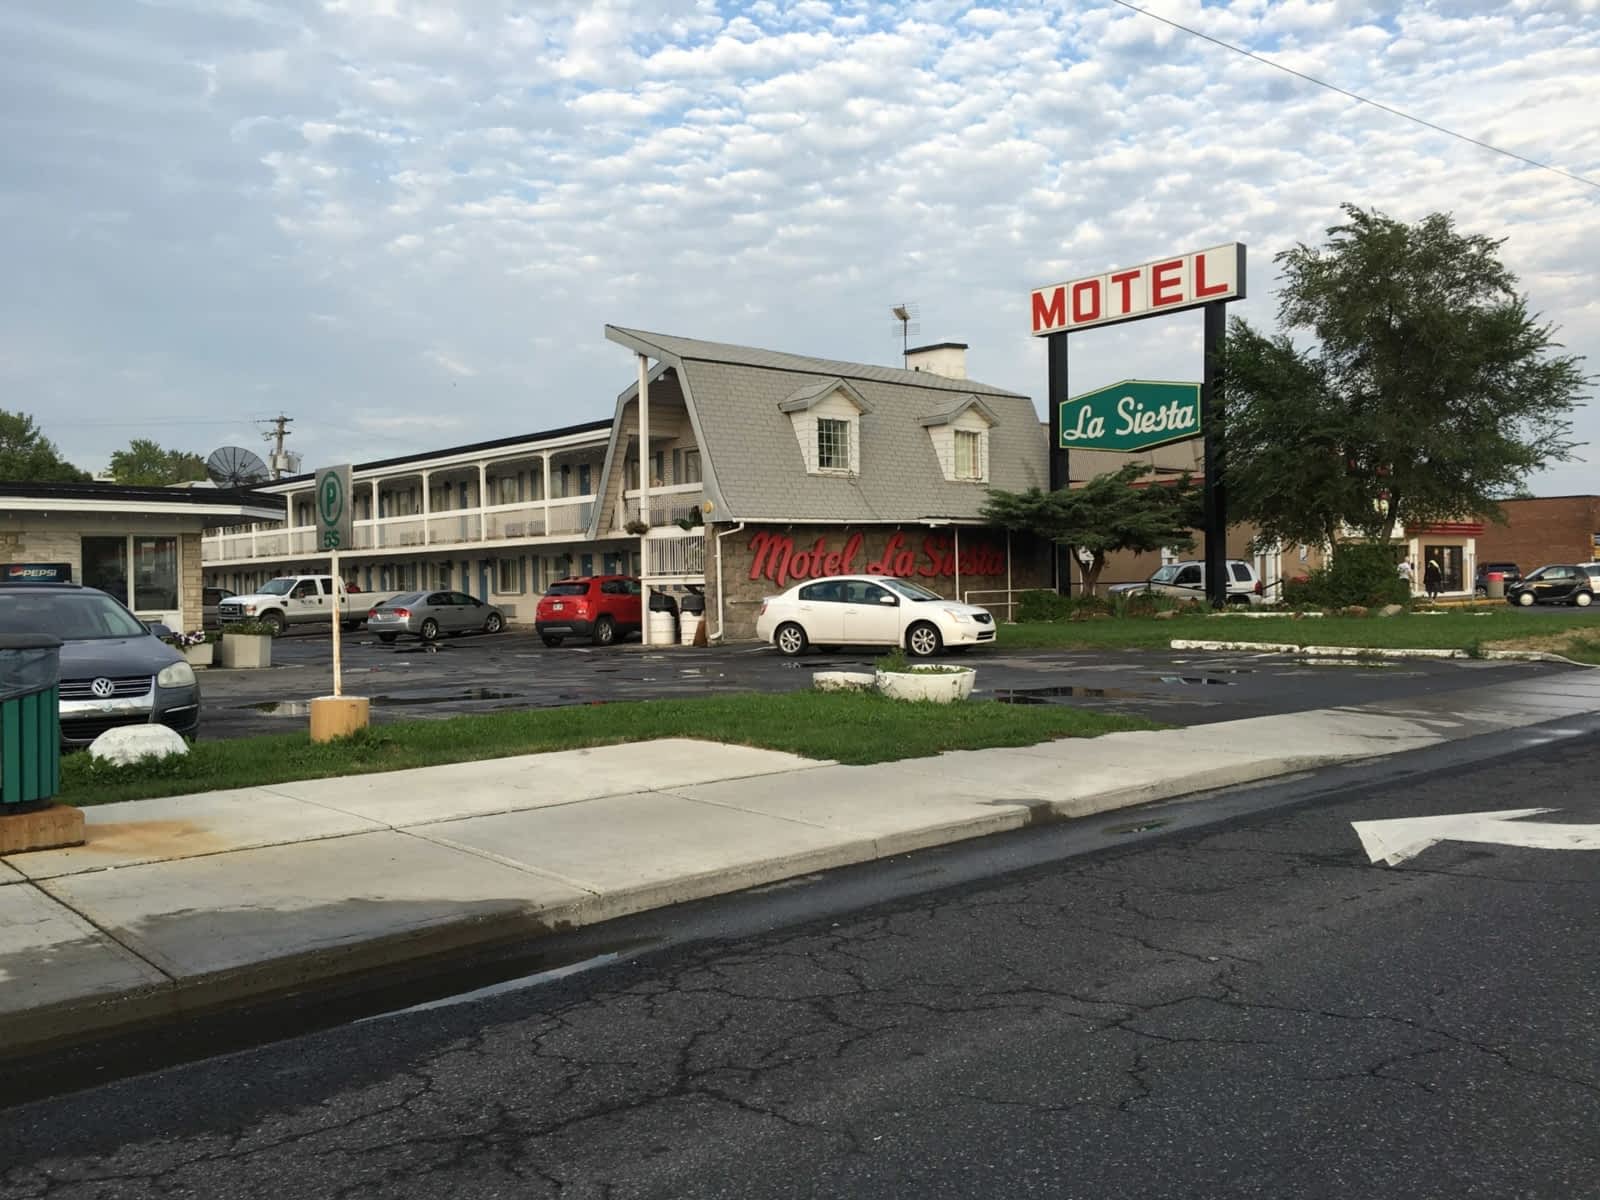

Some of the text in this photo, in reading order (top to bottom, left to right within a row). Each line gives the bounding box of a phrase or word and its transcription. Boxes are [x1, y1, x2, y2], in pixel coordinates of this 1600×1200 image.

[1031, 254, 1229, 332] MOTEL
[1063, 396, 1196, 440] La Siesta
[326, 481, 337, 517] P
[748, 530, 1006, 587] Motel La Siesta
